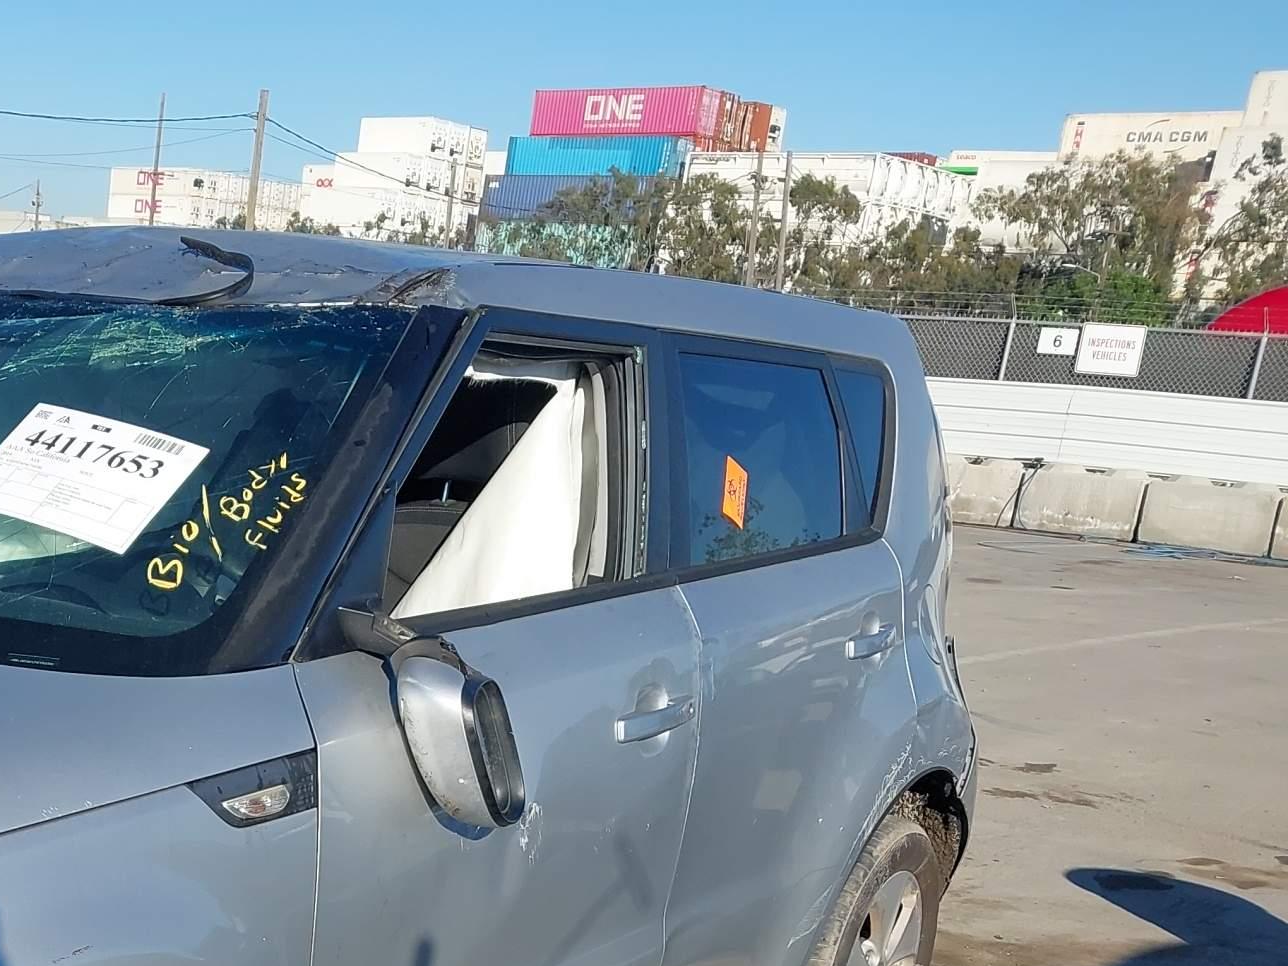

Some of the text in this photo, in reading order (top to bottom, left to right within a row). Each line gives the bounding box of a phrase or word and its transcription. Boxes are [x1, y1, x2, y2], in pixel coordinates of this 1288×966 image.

[583, 94, 644, 121] ONE
[1126, 131, 1208, 142] CMA CGM
[137, 171, 164, 185] ONE
[134, 199, 162, 213] ONE
[1053, 334, 1063, 348] 6
[1088, 337, 1136, 350] INSPECTIONS
[1092, 350, 1127, 362] VEHICLES
[25, 429, 165, 479] 44117653
